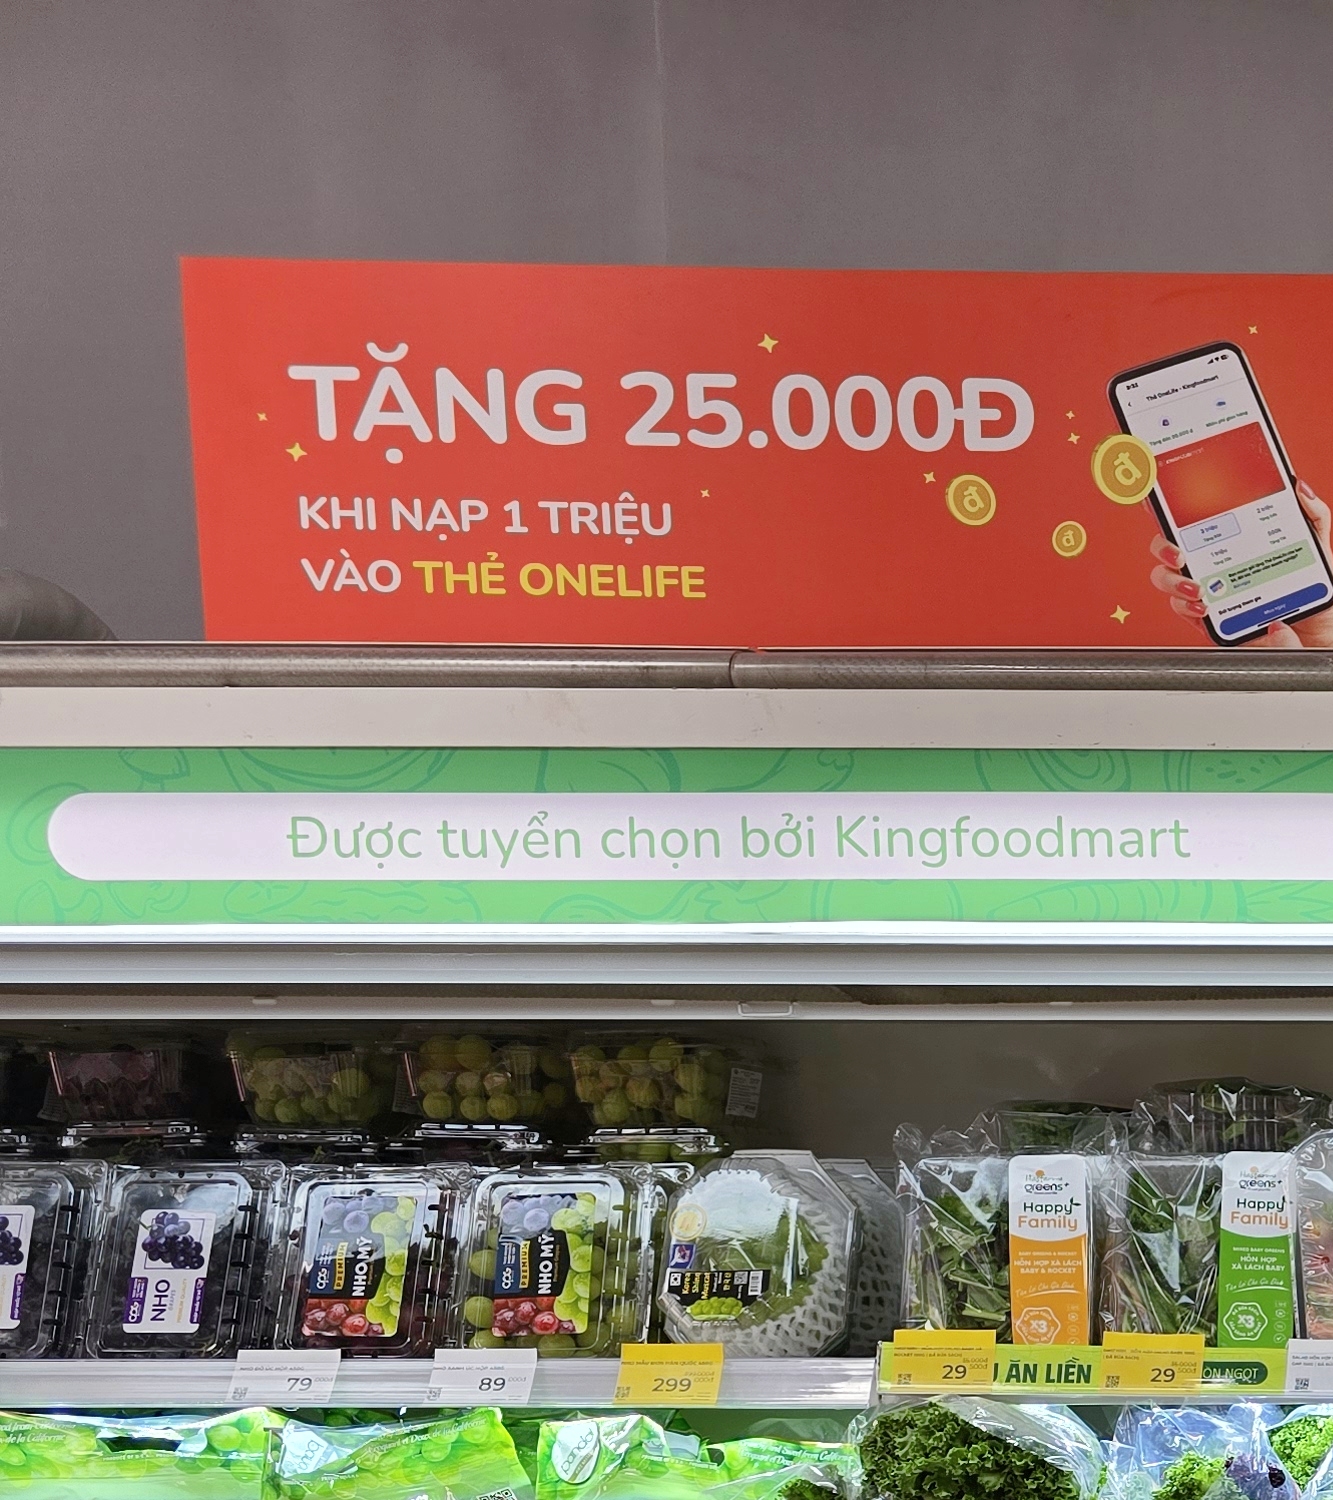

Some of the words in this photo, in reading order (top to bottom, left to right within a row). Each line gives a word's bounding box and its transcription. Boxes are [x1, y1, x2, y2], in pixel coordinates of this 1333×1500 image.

[287, 342, 586, 463] TẶNG
[620, 371, 1034, 452] 25.000Đ
[300, 496, 376, 530] KHI
[391, 498, 488, 540] NẠP
[504, 501, 528, 532] 1
[538, 492, 671, 544] TRIỆU
[301, 549, 401, 592] VÀO
[413, 552, 506, 594] THẺ
[520, 563, 706, 597] ONELIFE
[286, 815, 424, 870] Được
[435, 811, 583, 869] tuyển
[601, 815, 722, 870] chọn
[742, 811, 816, 858] bởi
[836, 814, 1192, 870] Kingfoodmart
[1017, 1214, 1078, 1232] Family
[1023, 1201, 1073, 1216] Happy
[335, 1243, 346, 1287] PREMIUM
[352, 1262, 367, 1297] NHO
[150, 1279, 171, 1322] NHO
[652, 1378, 691, 1392] 299
[943, 1365, 966, 1379] 29
